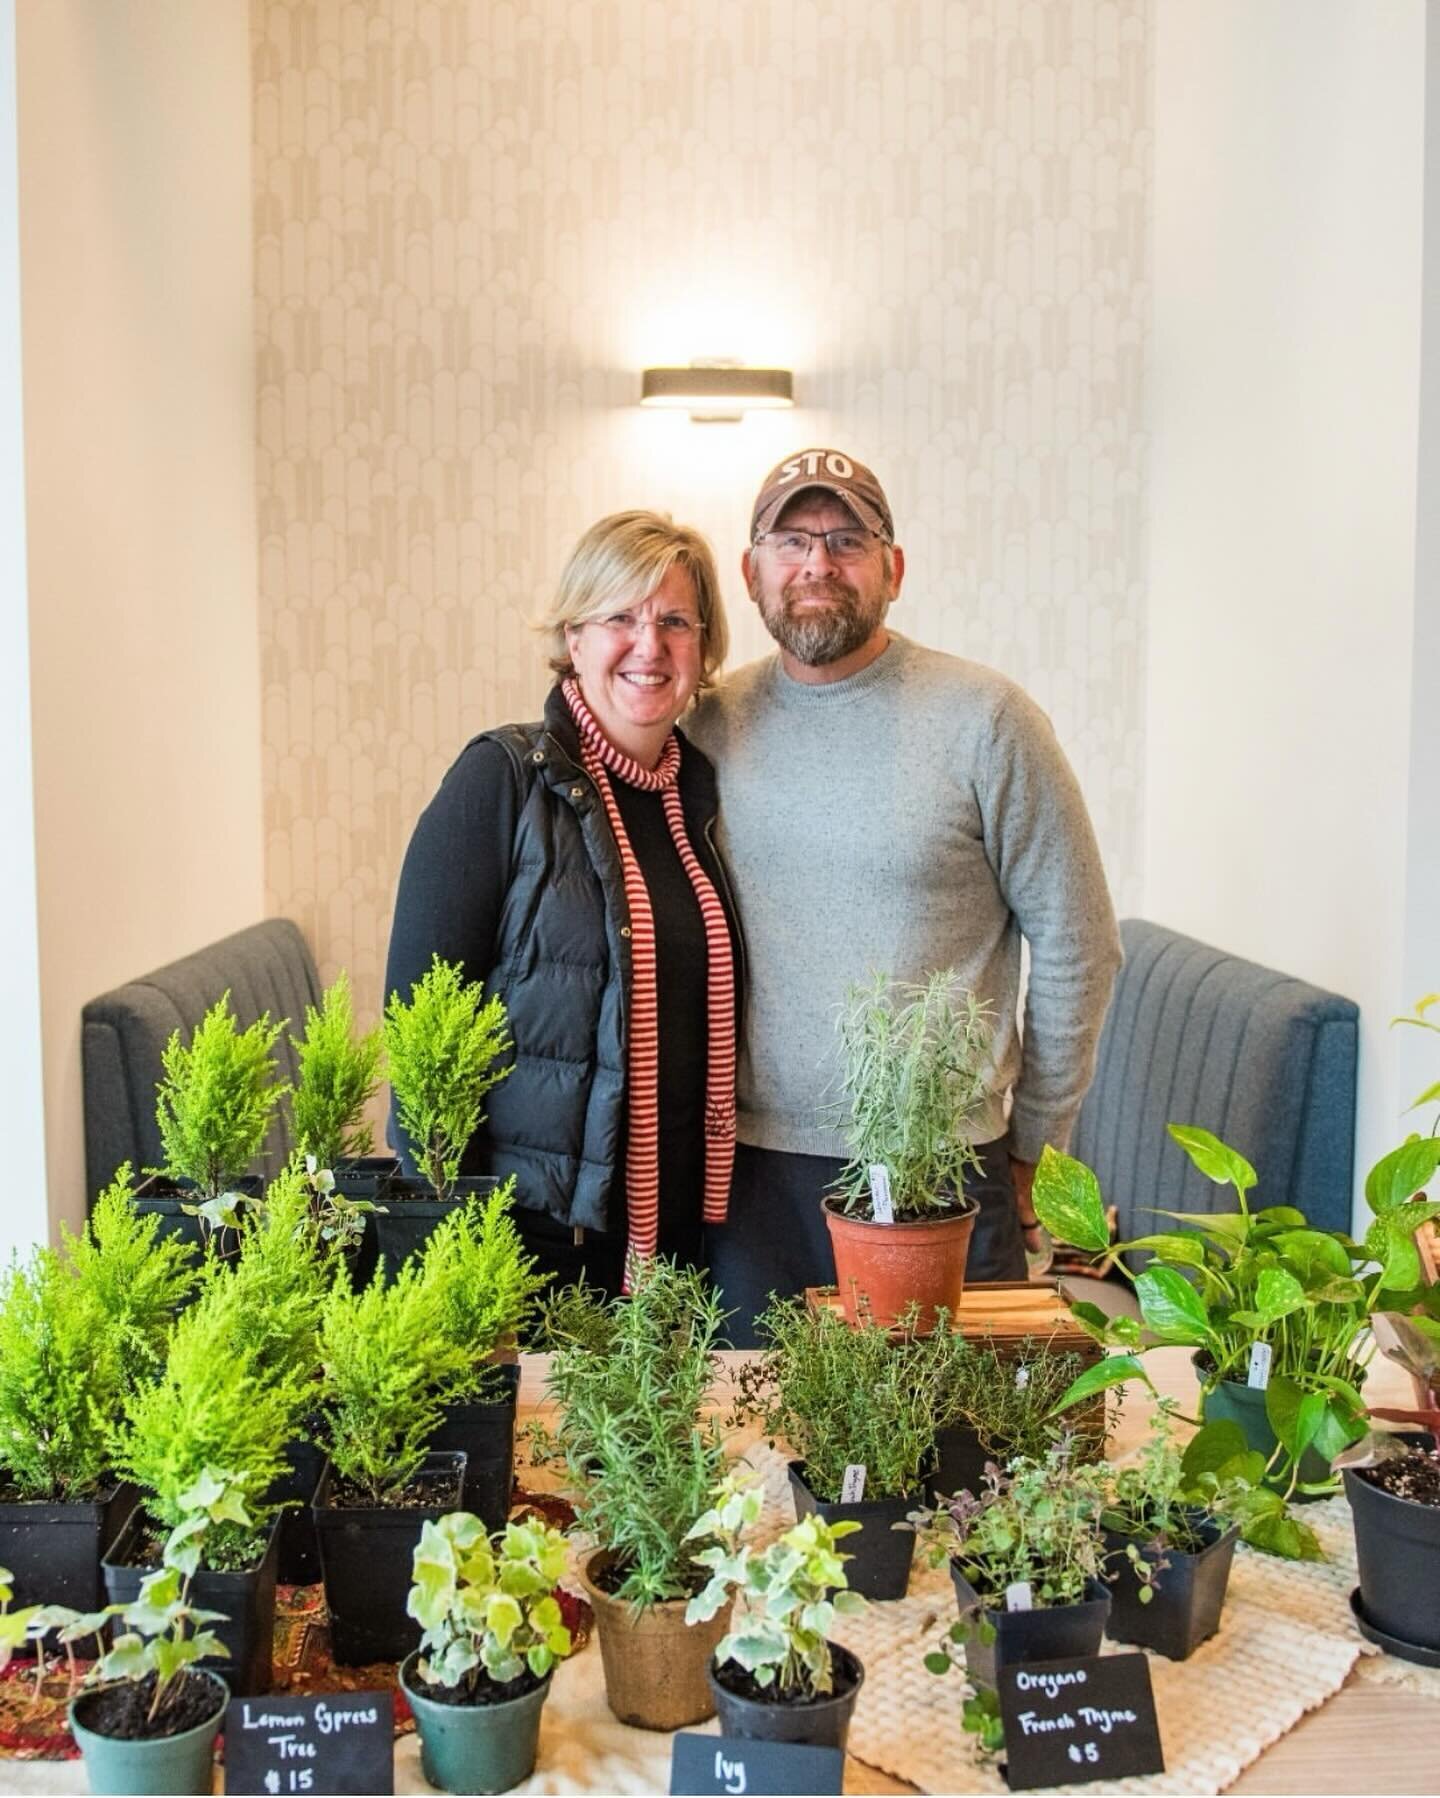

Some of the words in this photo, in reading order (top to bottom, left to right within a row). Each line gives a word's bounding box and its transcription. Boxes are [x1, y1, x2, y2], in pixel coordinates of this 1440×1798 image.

[778, 451, 854, 485] STO
[1016, 1670, 1087, 1699] Oregano
[242, 1704, 305, 1729] Lemon
[314, 1702, 378, 1734] Cypress
[1018, 1711, 1075, 1735] French
[1077, 1707, 1137, 1734] Thyme
[267, 1734, 317, 1760] Tree
[1068, 1742, 1099, 1763] $5
[714, 1750, 747, 1794] Ivy
